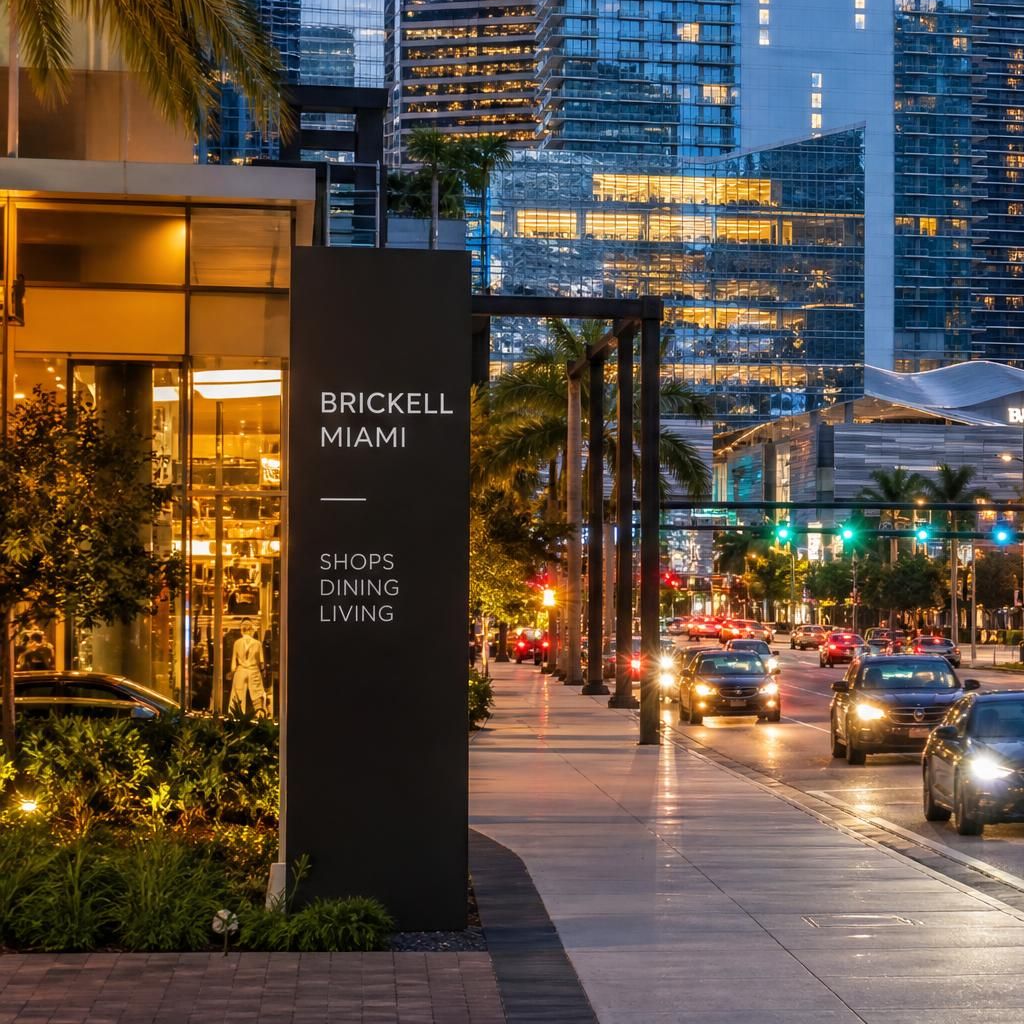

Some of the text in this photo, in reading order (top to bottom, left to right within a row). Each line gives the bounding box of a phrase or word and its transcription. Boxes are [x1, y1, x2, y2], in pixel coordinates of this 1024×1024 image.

[321, 391, 454, 415] BRICKELL
[320, 426, 406, 448] MIAMI
[320, 553, 395, 571] SHOPS
[320, 578, 400, 597] DINING
[320, 604, 395, 623] LIVING
